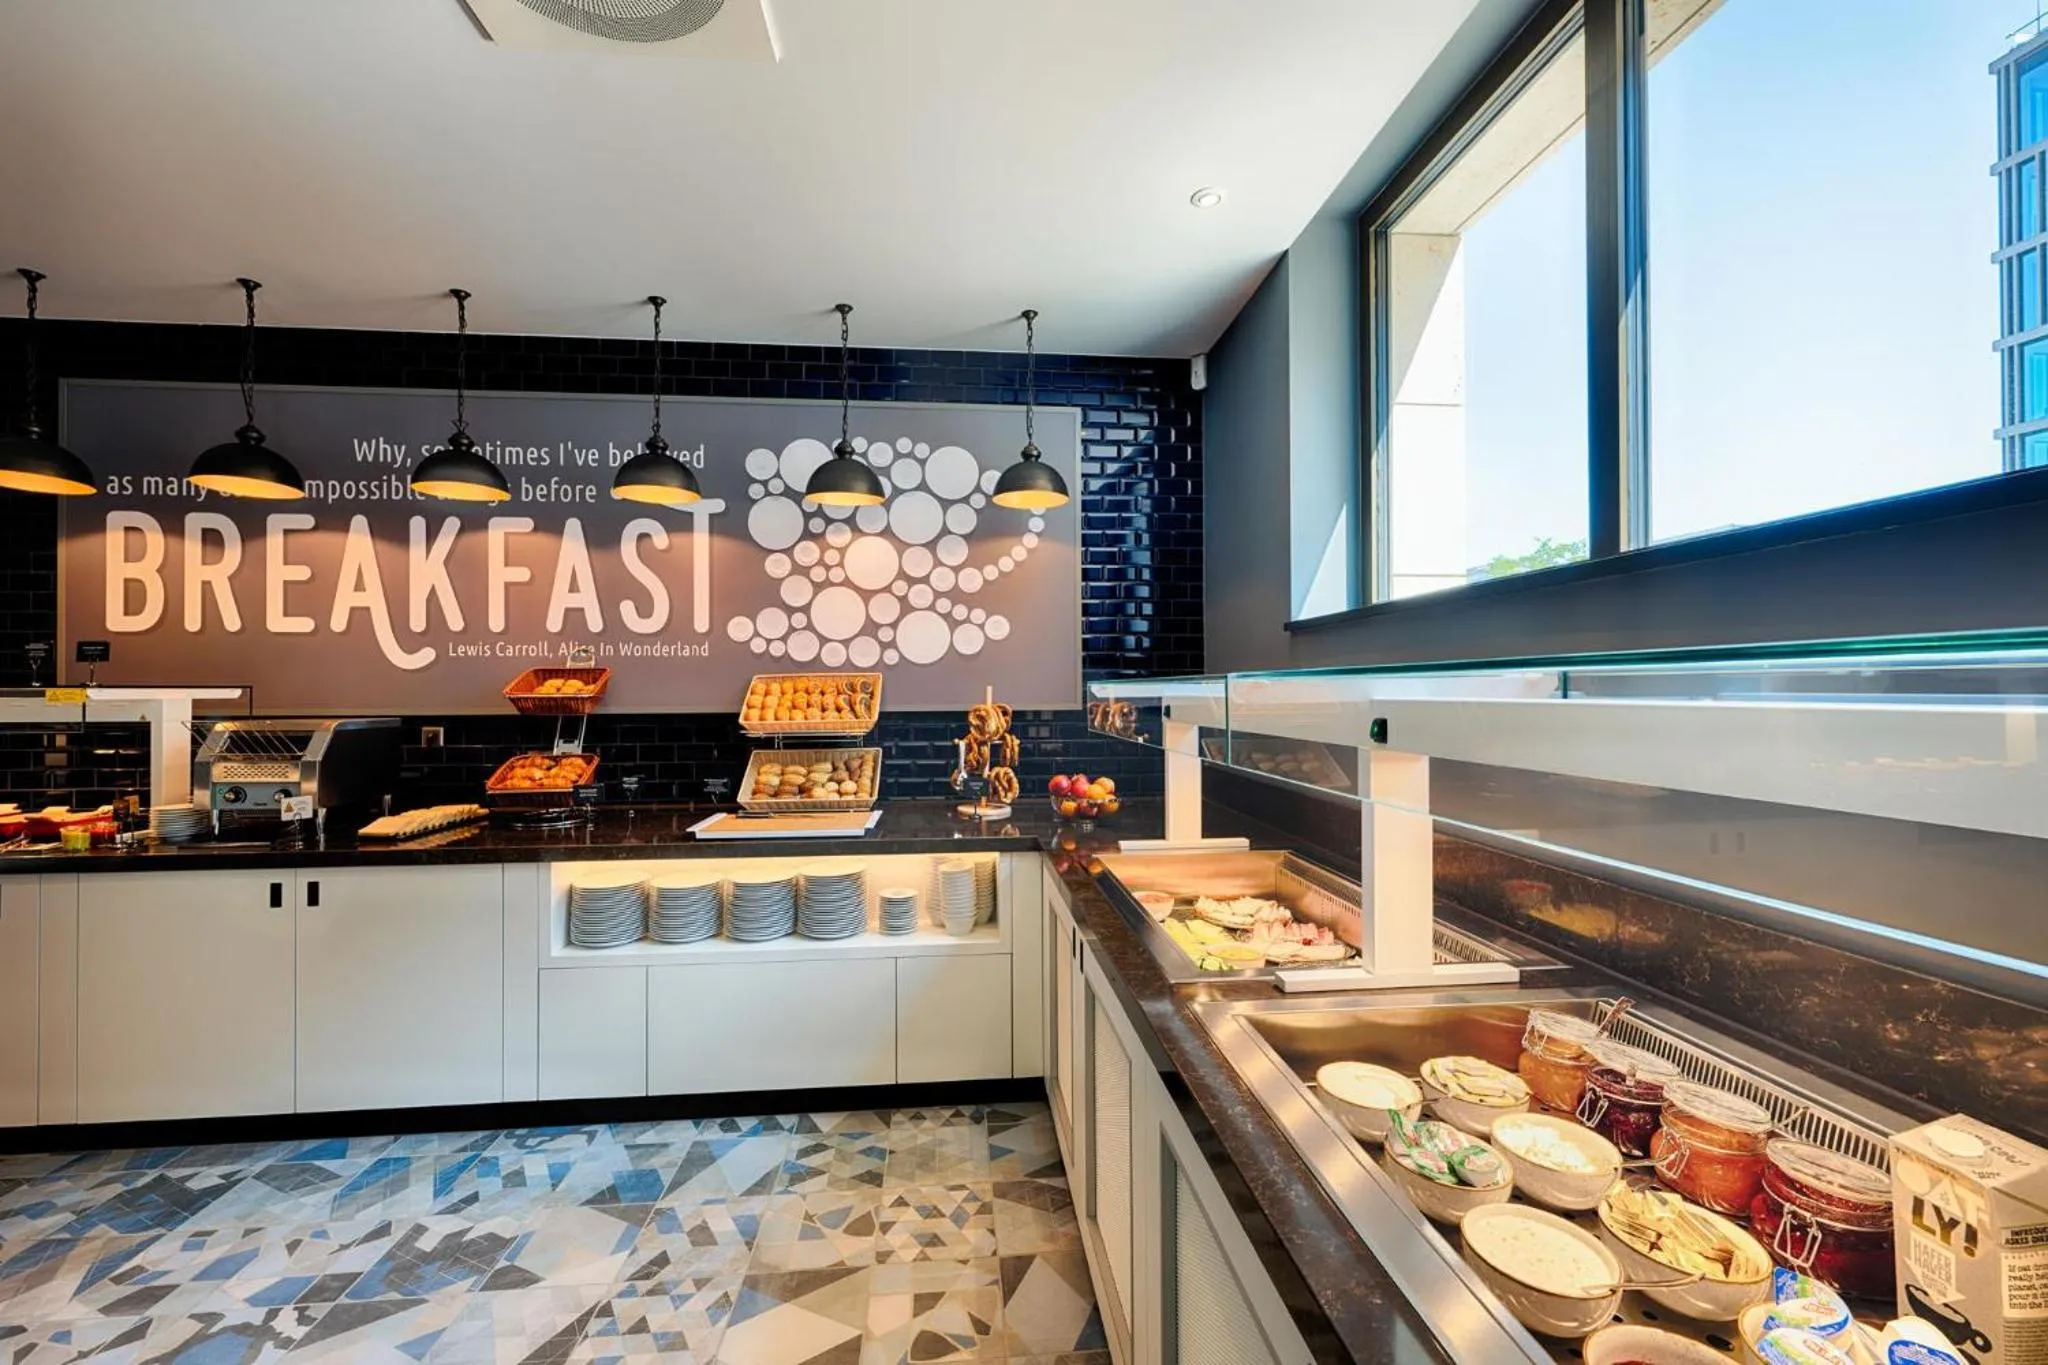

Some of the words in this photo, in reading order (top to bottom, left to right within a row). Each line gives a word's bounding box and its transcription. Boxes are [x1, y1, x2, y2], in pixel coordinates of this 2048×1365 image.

[353, 437, 411, 468] Why,
[421, 440, 551, 466] stimes
[560, 441, 599, 467] I've
[609, 441, 705, 469] beled
[106, 475, 133, 495] as
[143, 476, 207, 501] many
[303, 473, 426, 505] mpossibl
[521, 476, 597, 503] before
[105, 499, 726, 670] BREAKFAST
[448, 641, 490, 657] Lewis
[496, 641, 553, 660] Carroll,
[600, 641, 614, 657] In
[619, 642, 710, 657] Wonderland
[1911, 1195, 1978, 1258] LY!
